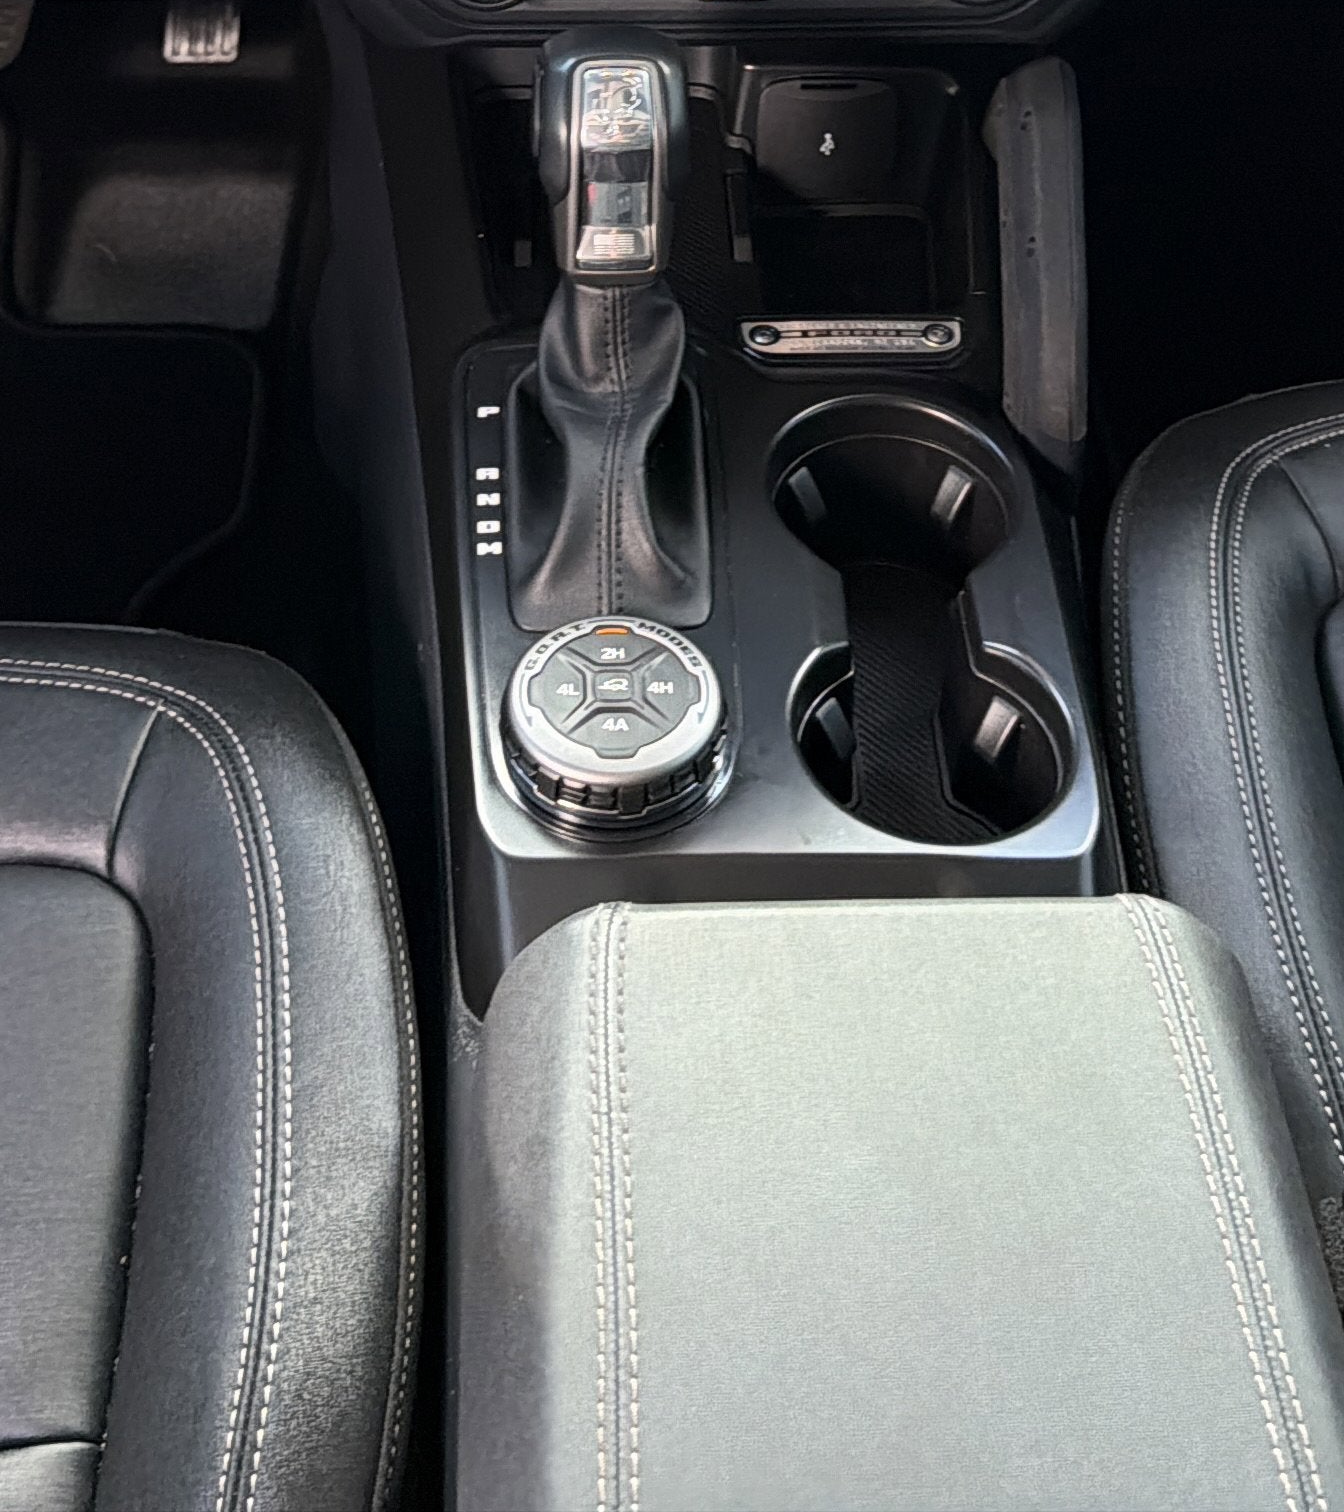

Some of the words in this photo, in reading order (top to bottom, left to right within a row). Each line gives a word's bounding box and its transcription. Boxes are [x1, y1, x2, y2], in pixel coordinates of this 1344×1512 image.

[476, 406, 500, 418] P
[476, 493, 501, 506] N
[476, 543, 502, 555] M
[637, 621, 703, 669] MODES
[600, 647, 626, 660] 2H
[556, 683, 580, 695] 4L
[647, 681, 673, 694] 4H
[601, 718, 629, 731] 4A
